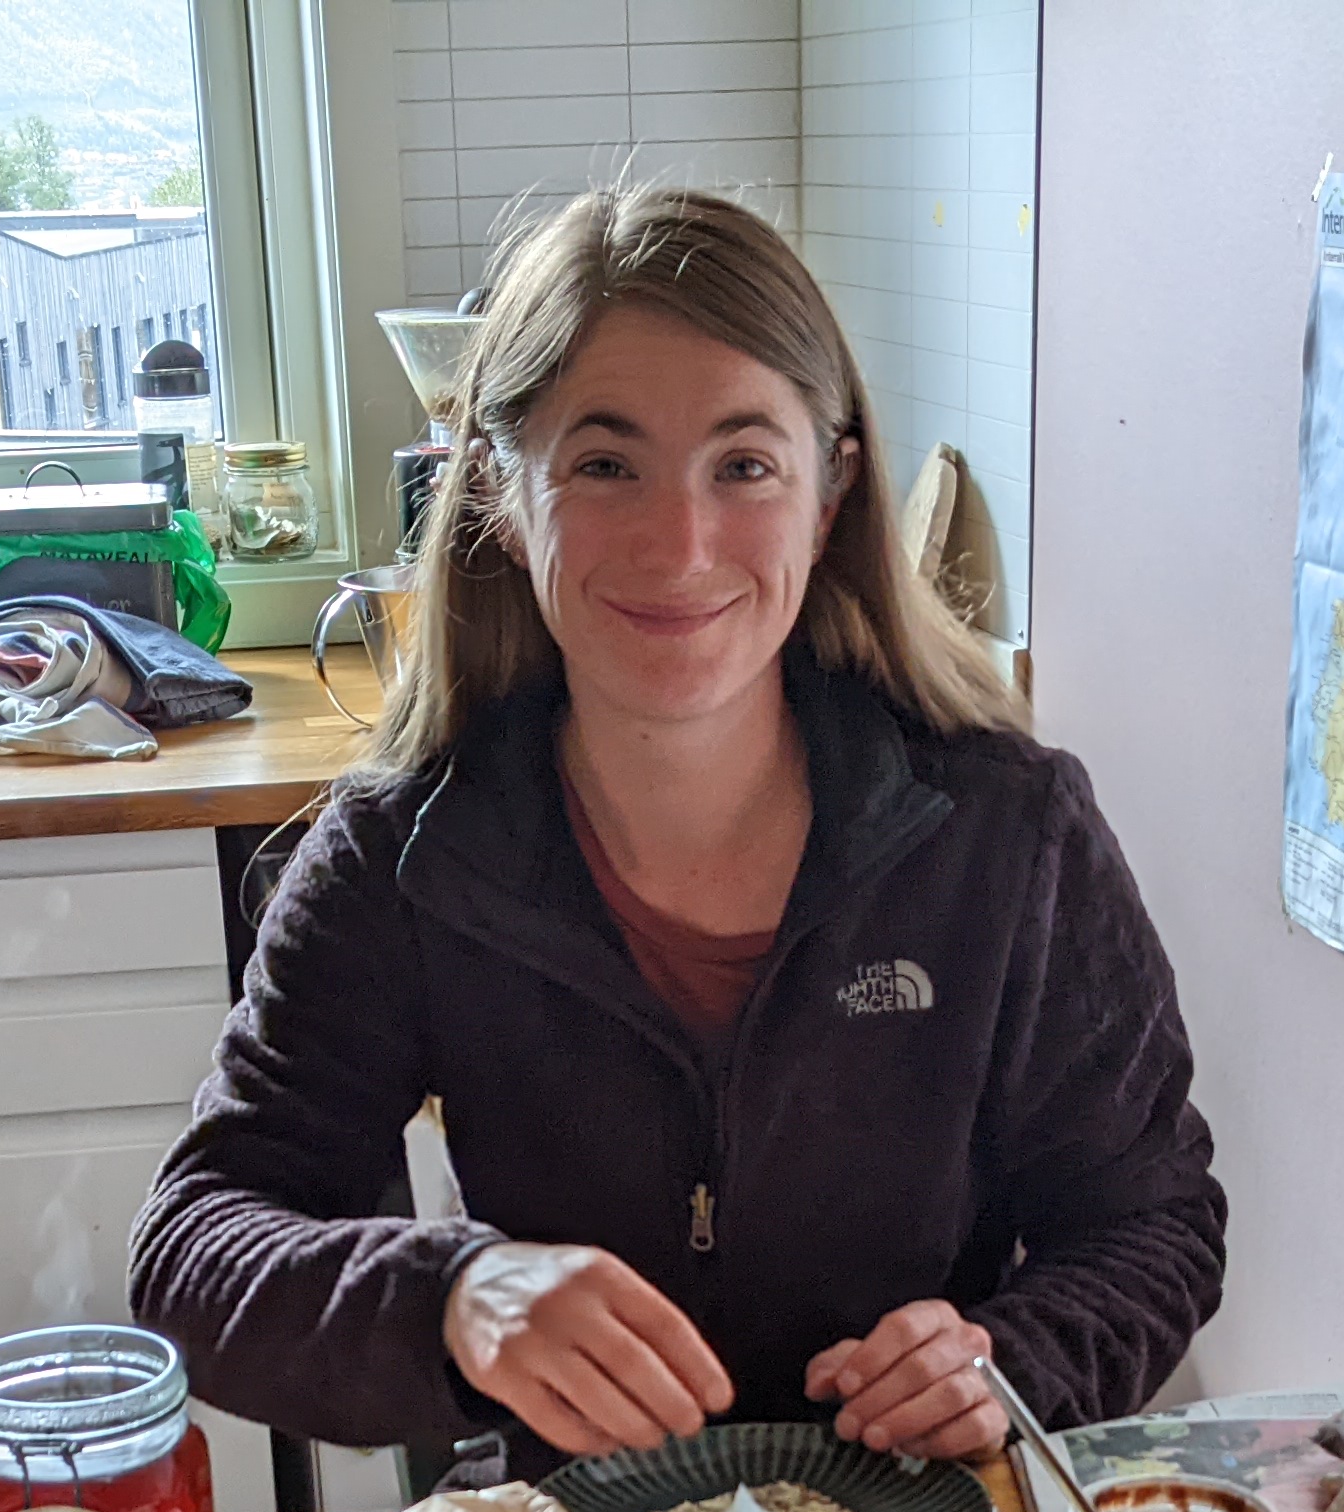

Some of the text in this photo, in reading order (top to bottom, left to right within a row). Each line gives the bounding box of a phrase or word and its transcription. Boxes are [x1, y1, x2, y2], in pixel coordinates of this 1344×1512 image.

[857, 960, 893, 980] THE
[836, 977, 895, 1003] NORTH
[846, 994, 897, 1018] FACE
